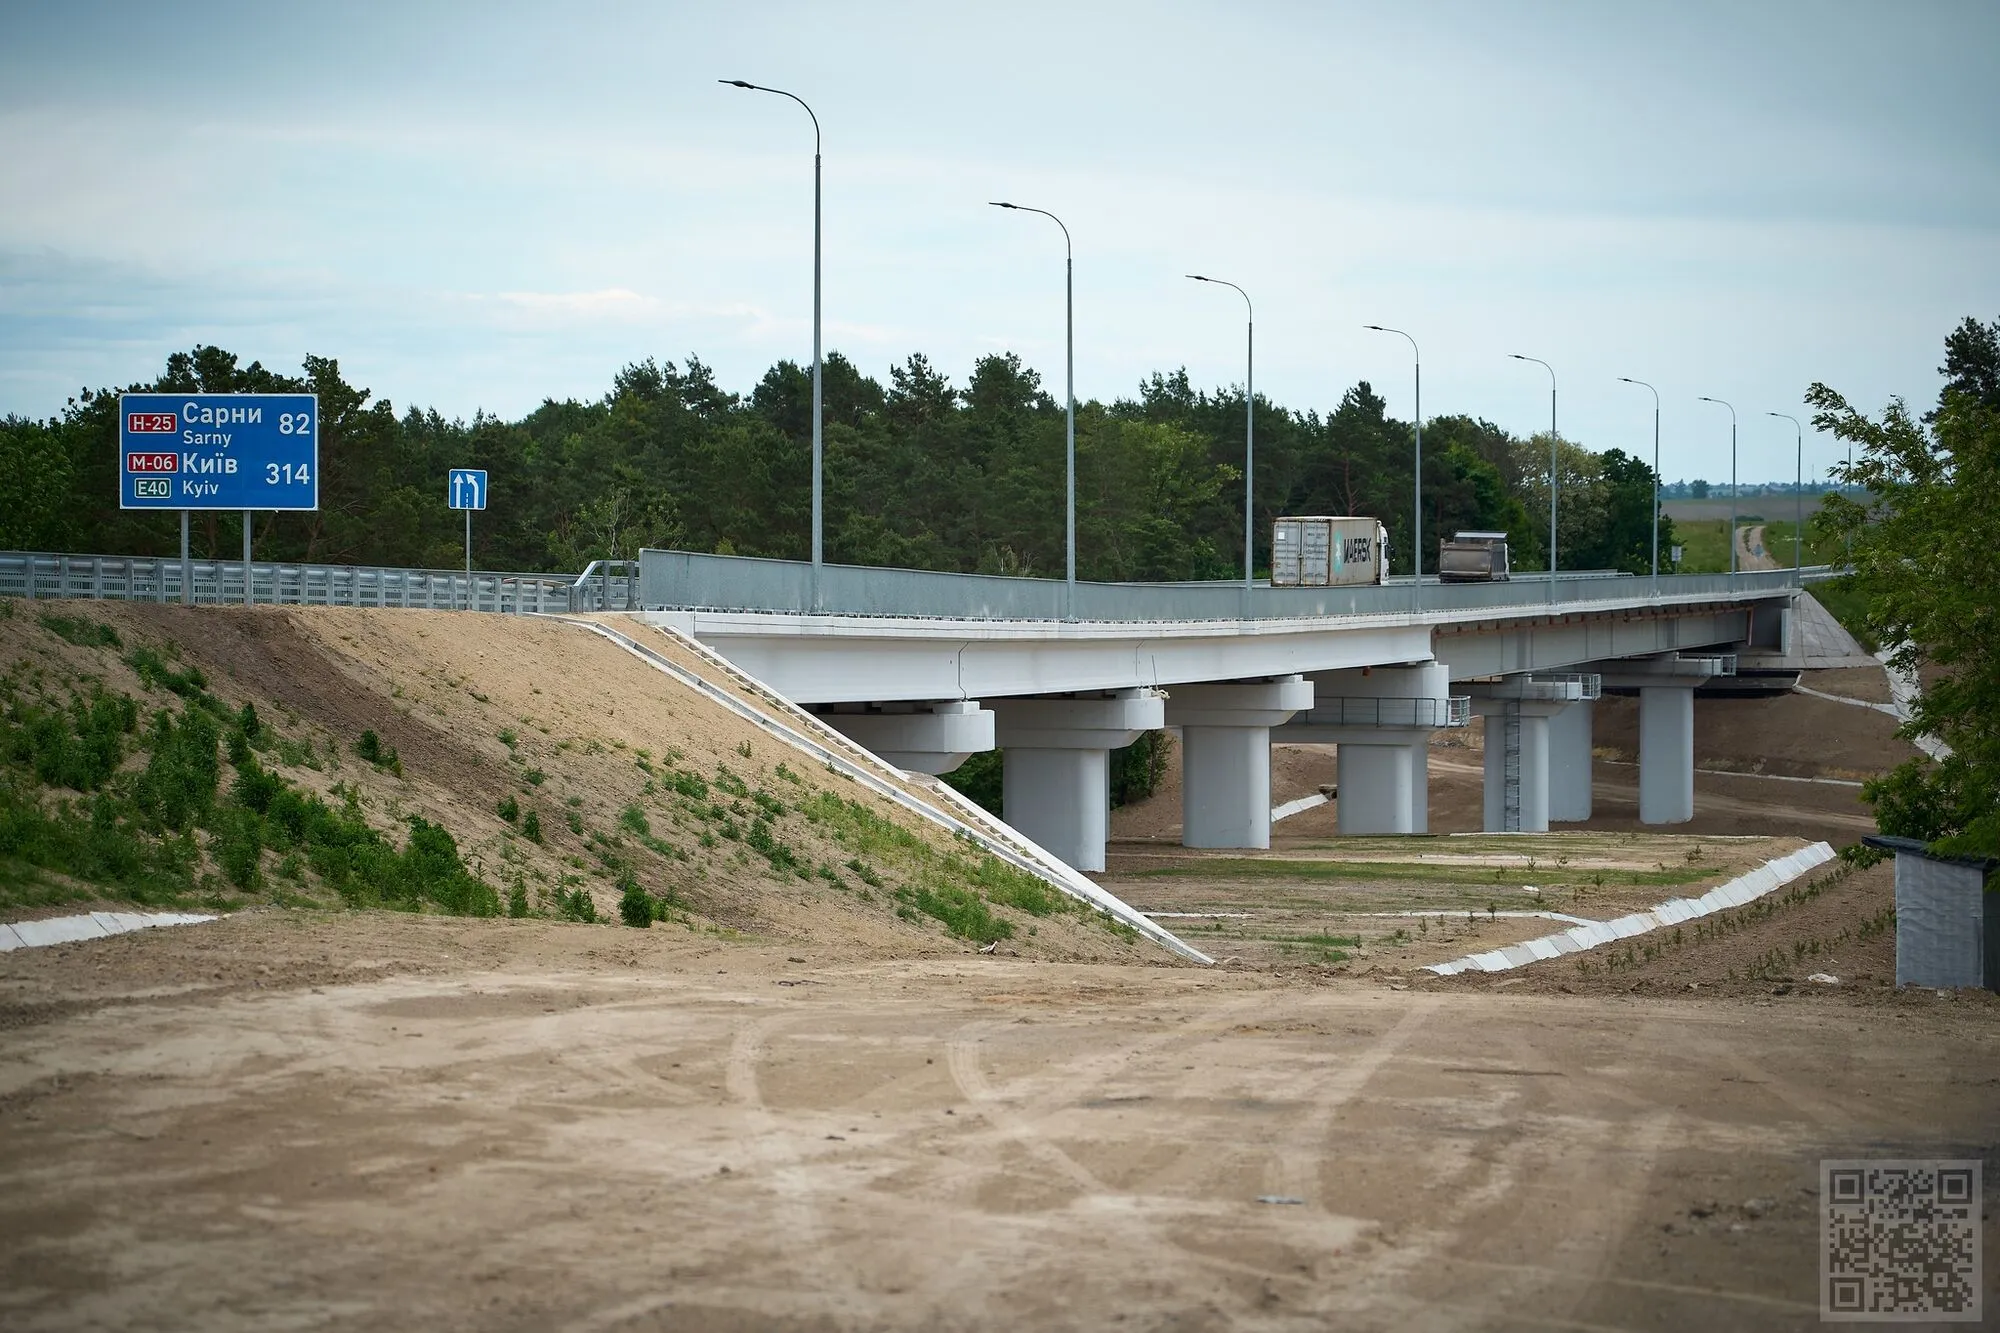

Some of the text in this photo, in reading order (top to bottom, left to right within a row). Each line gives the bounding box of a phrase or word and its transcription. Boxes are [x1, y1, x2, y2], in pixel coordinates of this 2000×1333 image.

[183, 401, 262, 428] Сарни
[279, 413, 310, 435] 82
[183, 430, 232, 447] Sarny
[183, 453, 238, 474] Київ
[265, 463, 310, 485] 314
[138, 481, 167, 496] E40
[183, 480, 219, 498] Kyiv
